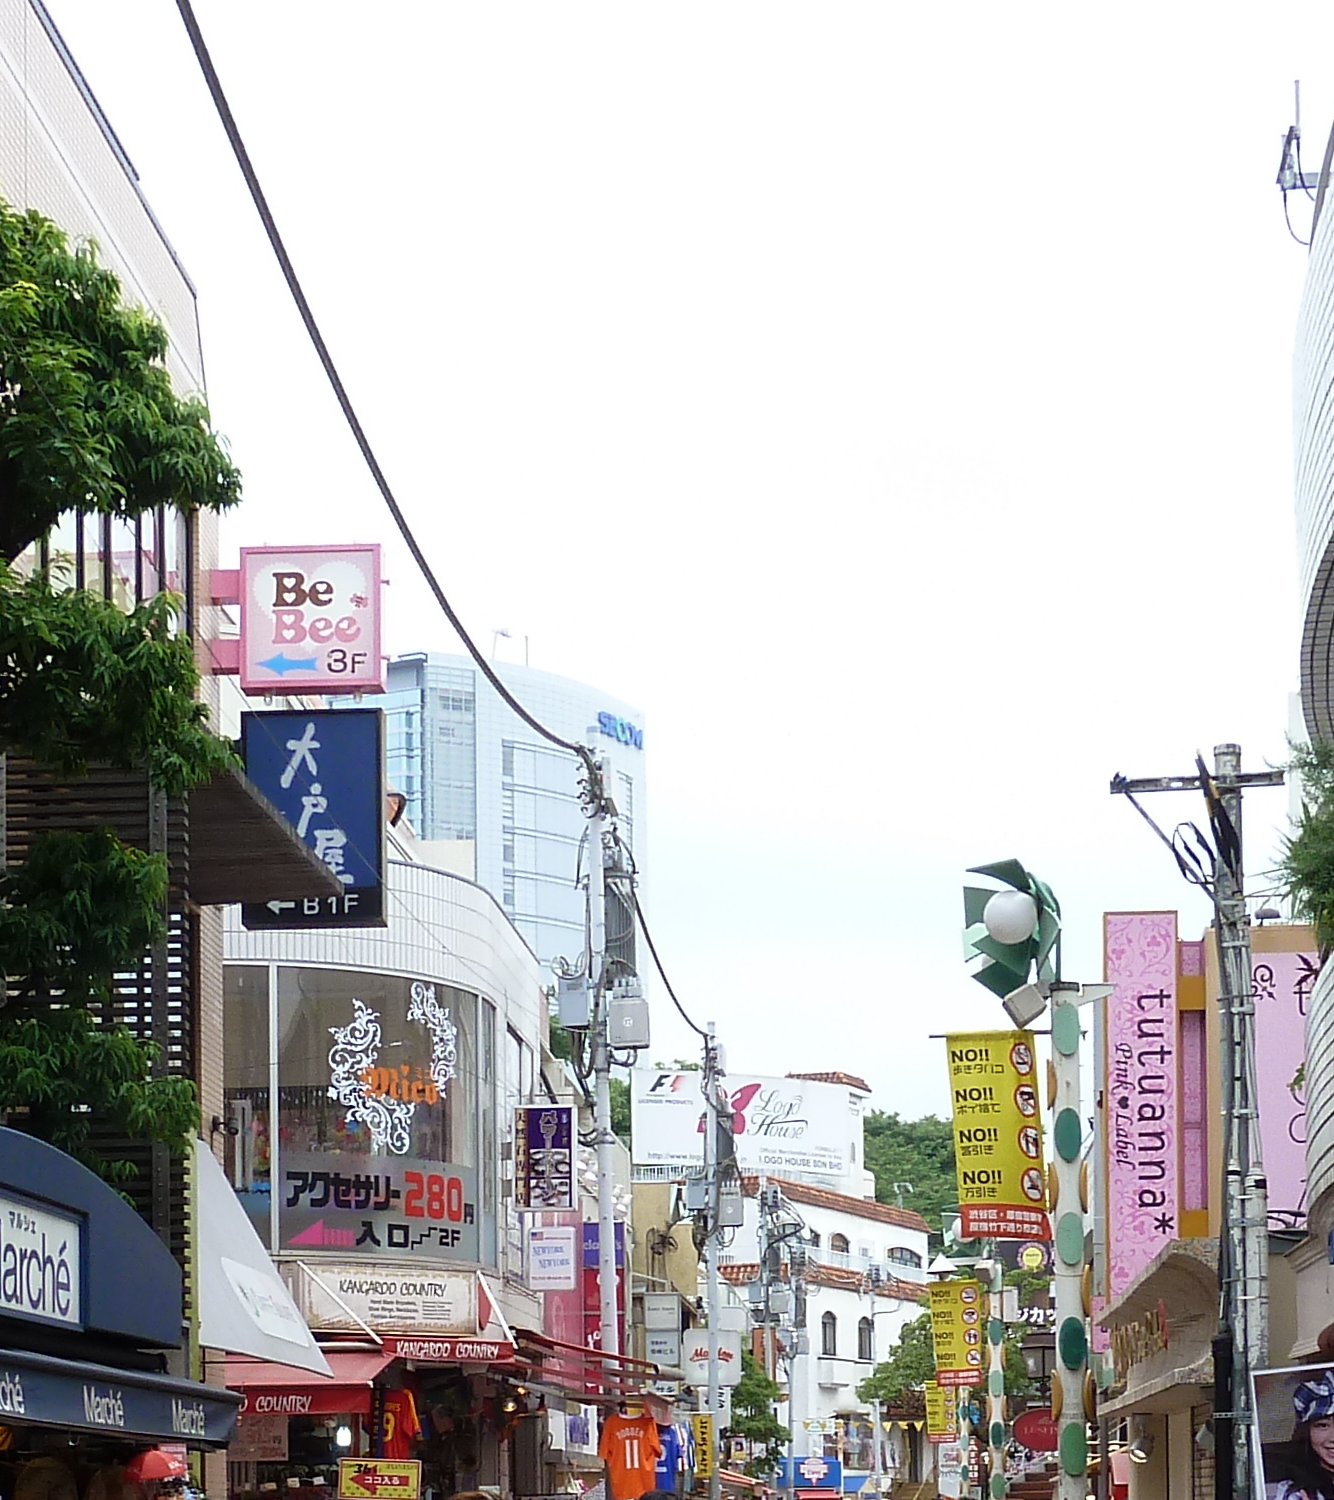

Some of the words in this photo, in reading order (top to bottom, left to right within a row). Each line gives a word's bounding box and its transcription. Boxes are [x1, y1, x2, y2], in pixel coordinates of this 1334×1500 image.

[271, 571, 334, 608] Be
[271, 609, 361, 645] Bee
[326, 649, 367, 674] 3F
[280, 722, 354, 886] 大戸屋
[951, 1048, 989, 1063] NO!!
[1113, 1042, 1135, 1096] Pink
[955, 1087, 993, 1103] NO!!
[959, 1128, 999, 1143] NO!!
[1115, 1113, 1135, 1171] Label
[963, 1170, 1002, 1185] NO!!
[286, 1171, 401, 1211] アクセサリー
[9, 1211, 37, 1235] マルシェ
[439, 1228, 461, 1247] 2F
[400, 1281, 447, 1298] COUNTRY
[456, 1342, 499, 1359] COUNTRY
[83, 1385, 124, 1427] Marché
[255, 1395, 312, 1413] COUNTRY
[172, 1399, 205, 1436] Marché
[625, 1439, 640, 1469] 11
